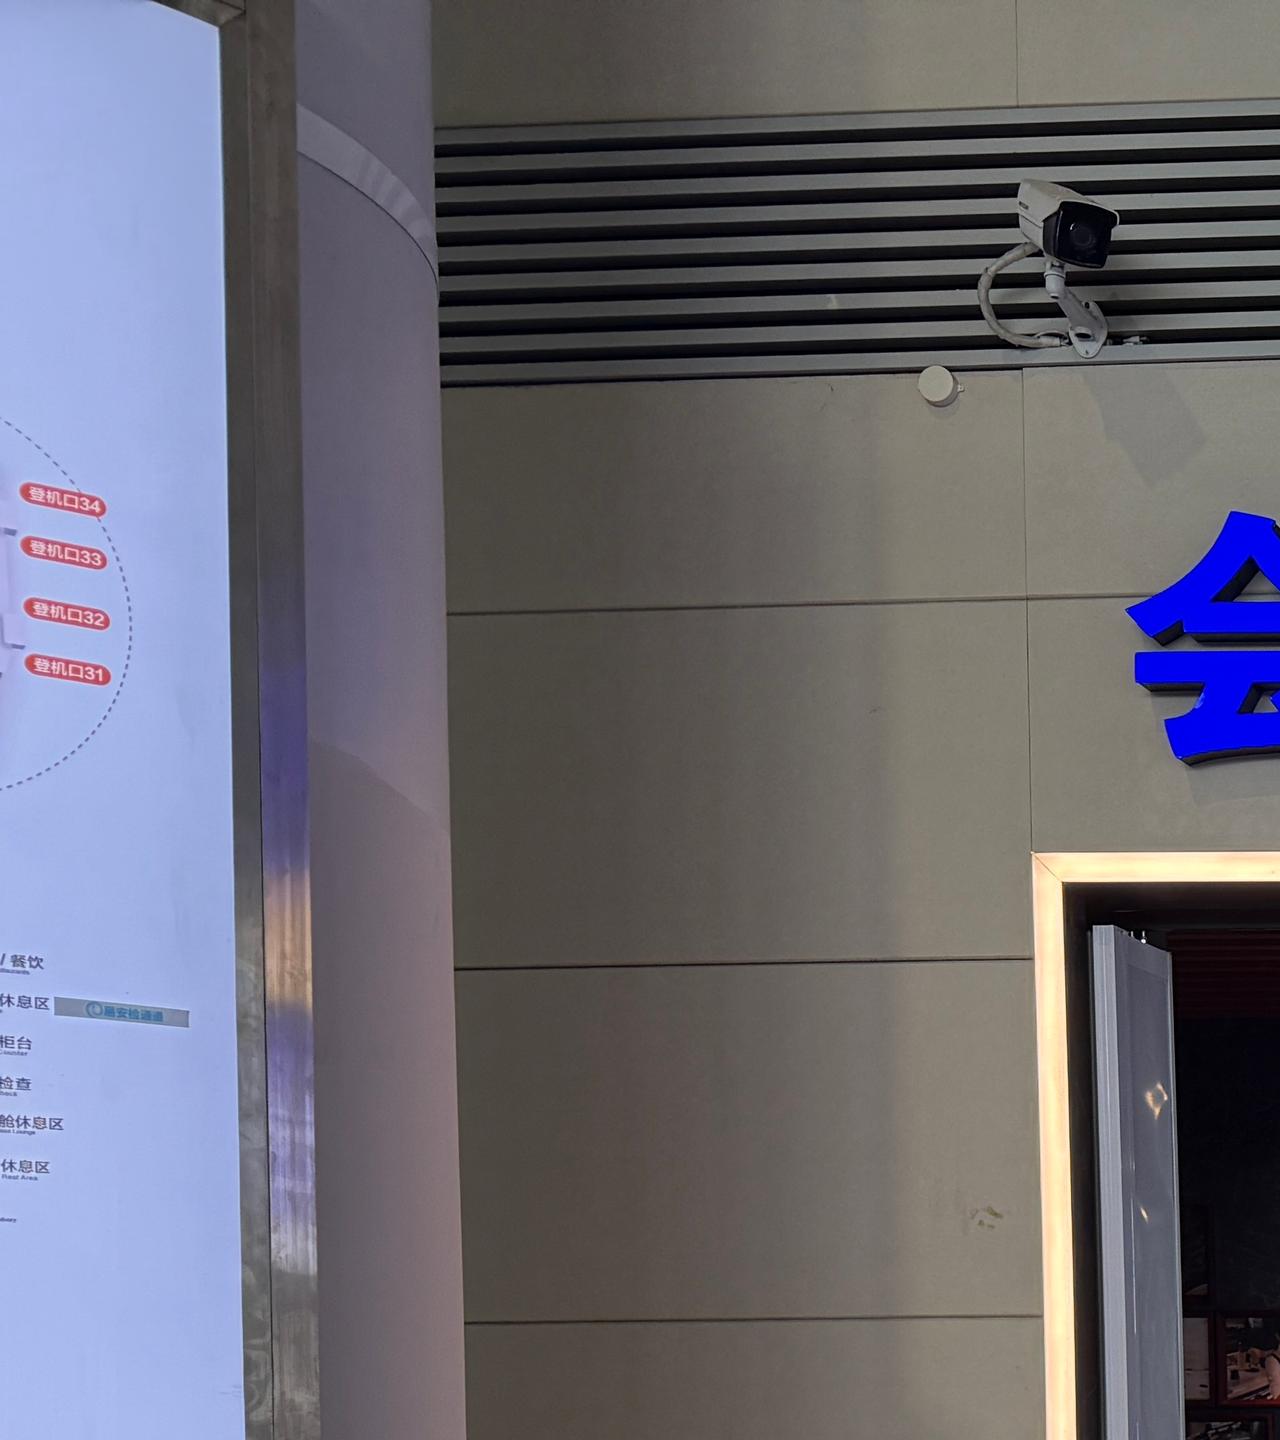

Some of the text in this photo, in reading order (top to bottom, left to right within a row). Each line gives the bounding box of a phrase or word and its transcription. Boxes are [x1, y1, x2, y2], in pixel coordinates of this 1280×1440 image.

[28, 487, 102, 513] 登机口34
[30, 540, 102, 566] 登机口33
[32, 601, 105, 627] 登机口32
[33, 658, 104, 681] 登机口31
[1, 1159, 50, 1174] 休息区
